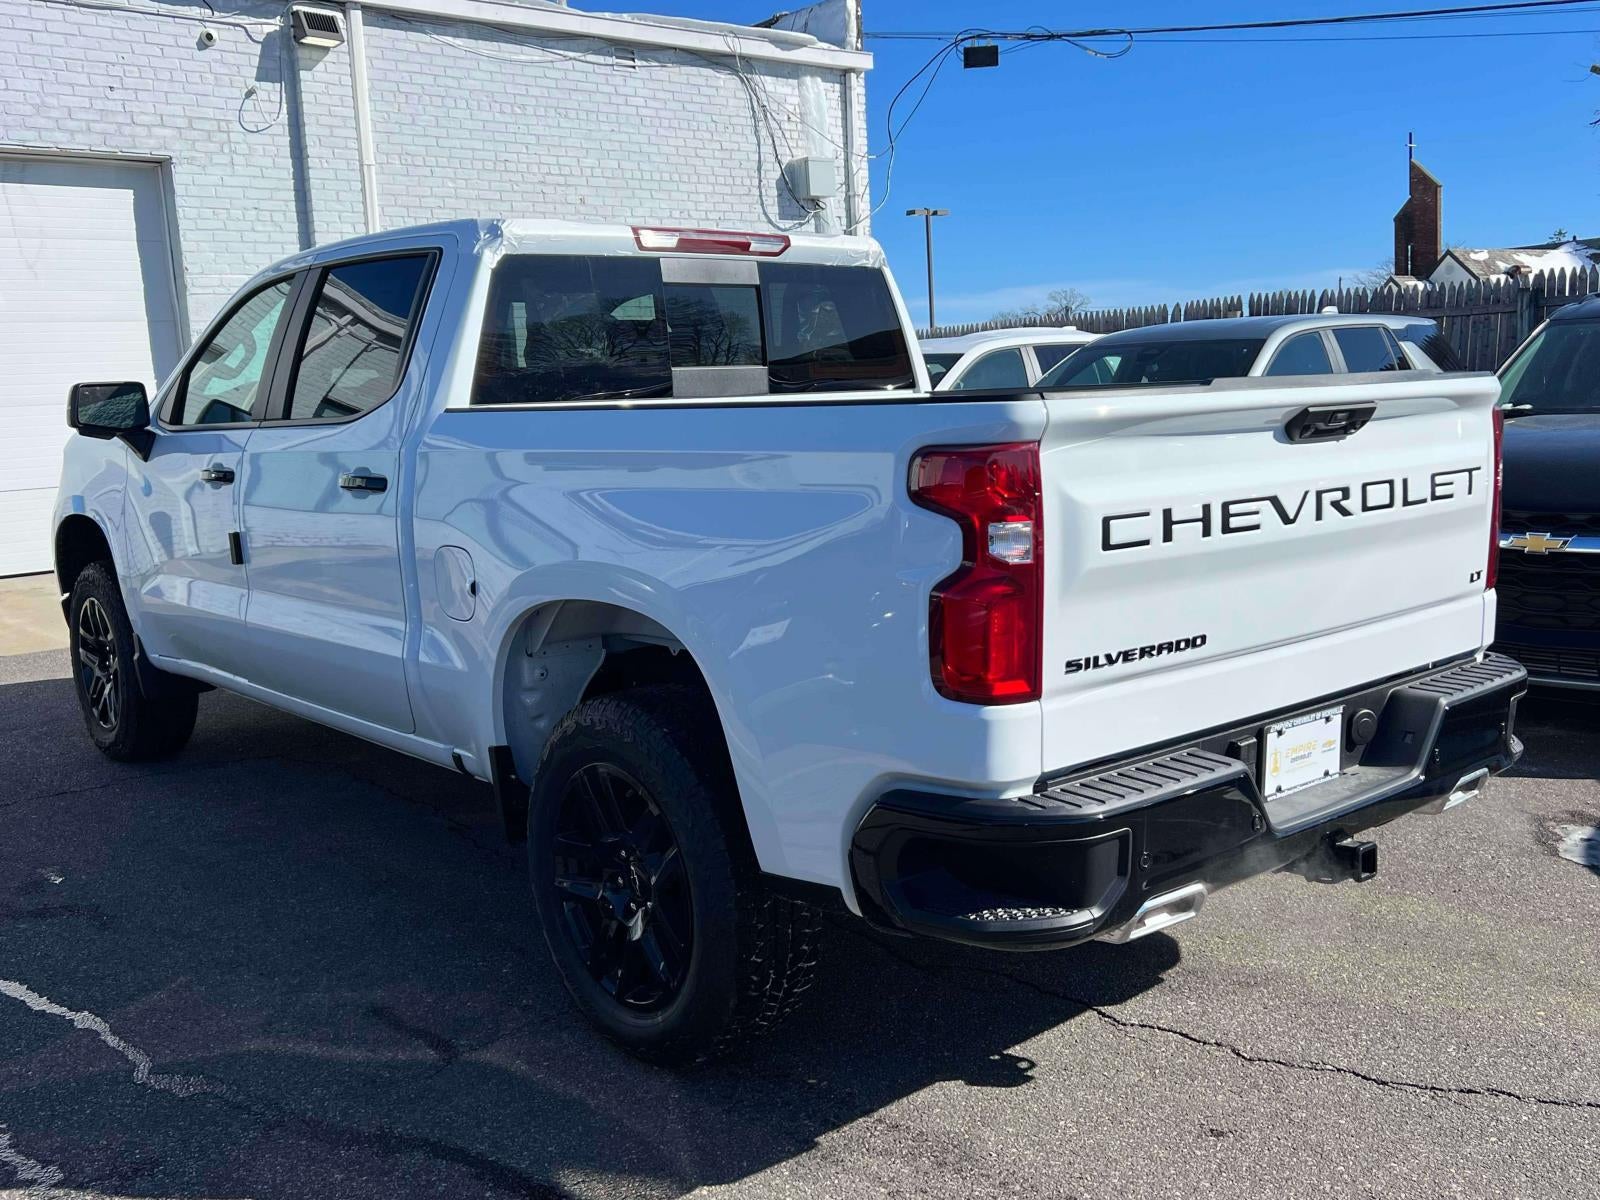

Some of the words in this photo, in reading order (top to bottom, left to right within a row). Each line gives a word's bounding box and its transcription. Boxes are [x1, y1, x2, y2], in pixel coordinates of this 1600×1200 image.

[1101, 466, 1482, 552] CHEVROLET
[1469, 569, 1483, 584] LT
[1064, 634, 1207, 675] SILVERADO
[1285, 740, 1318, 758] EMPIRE
